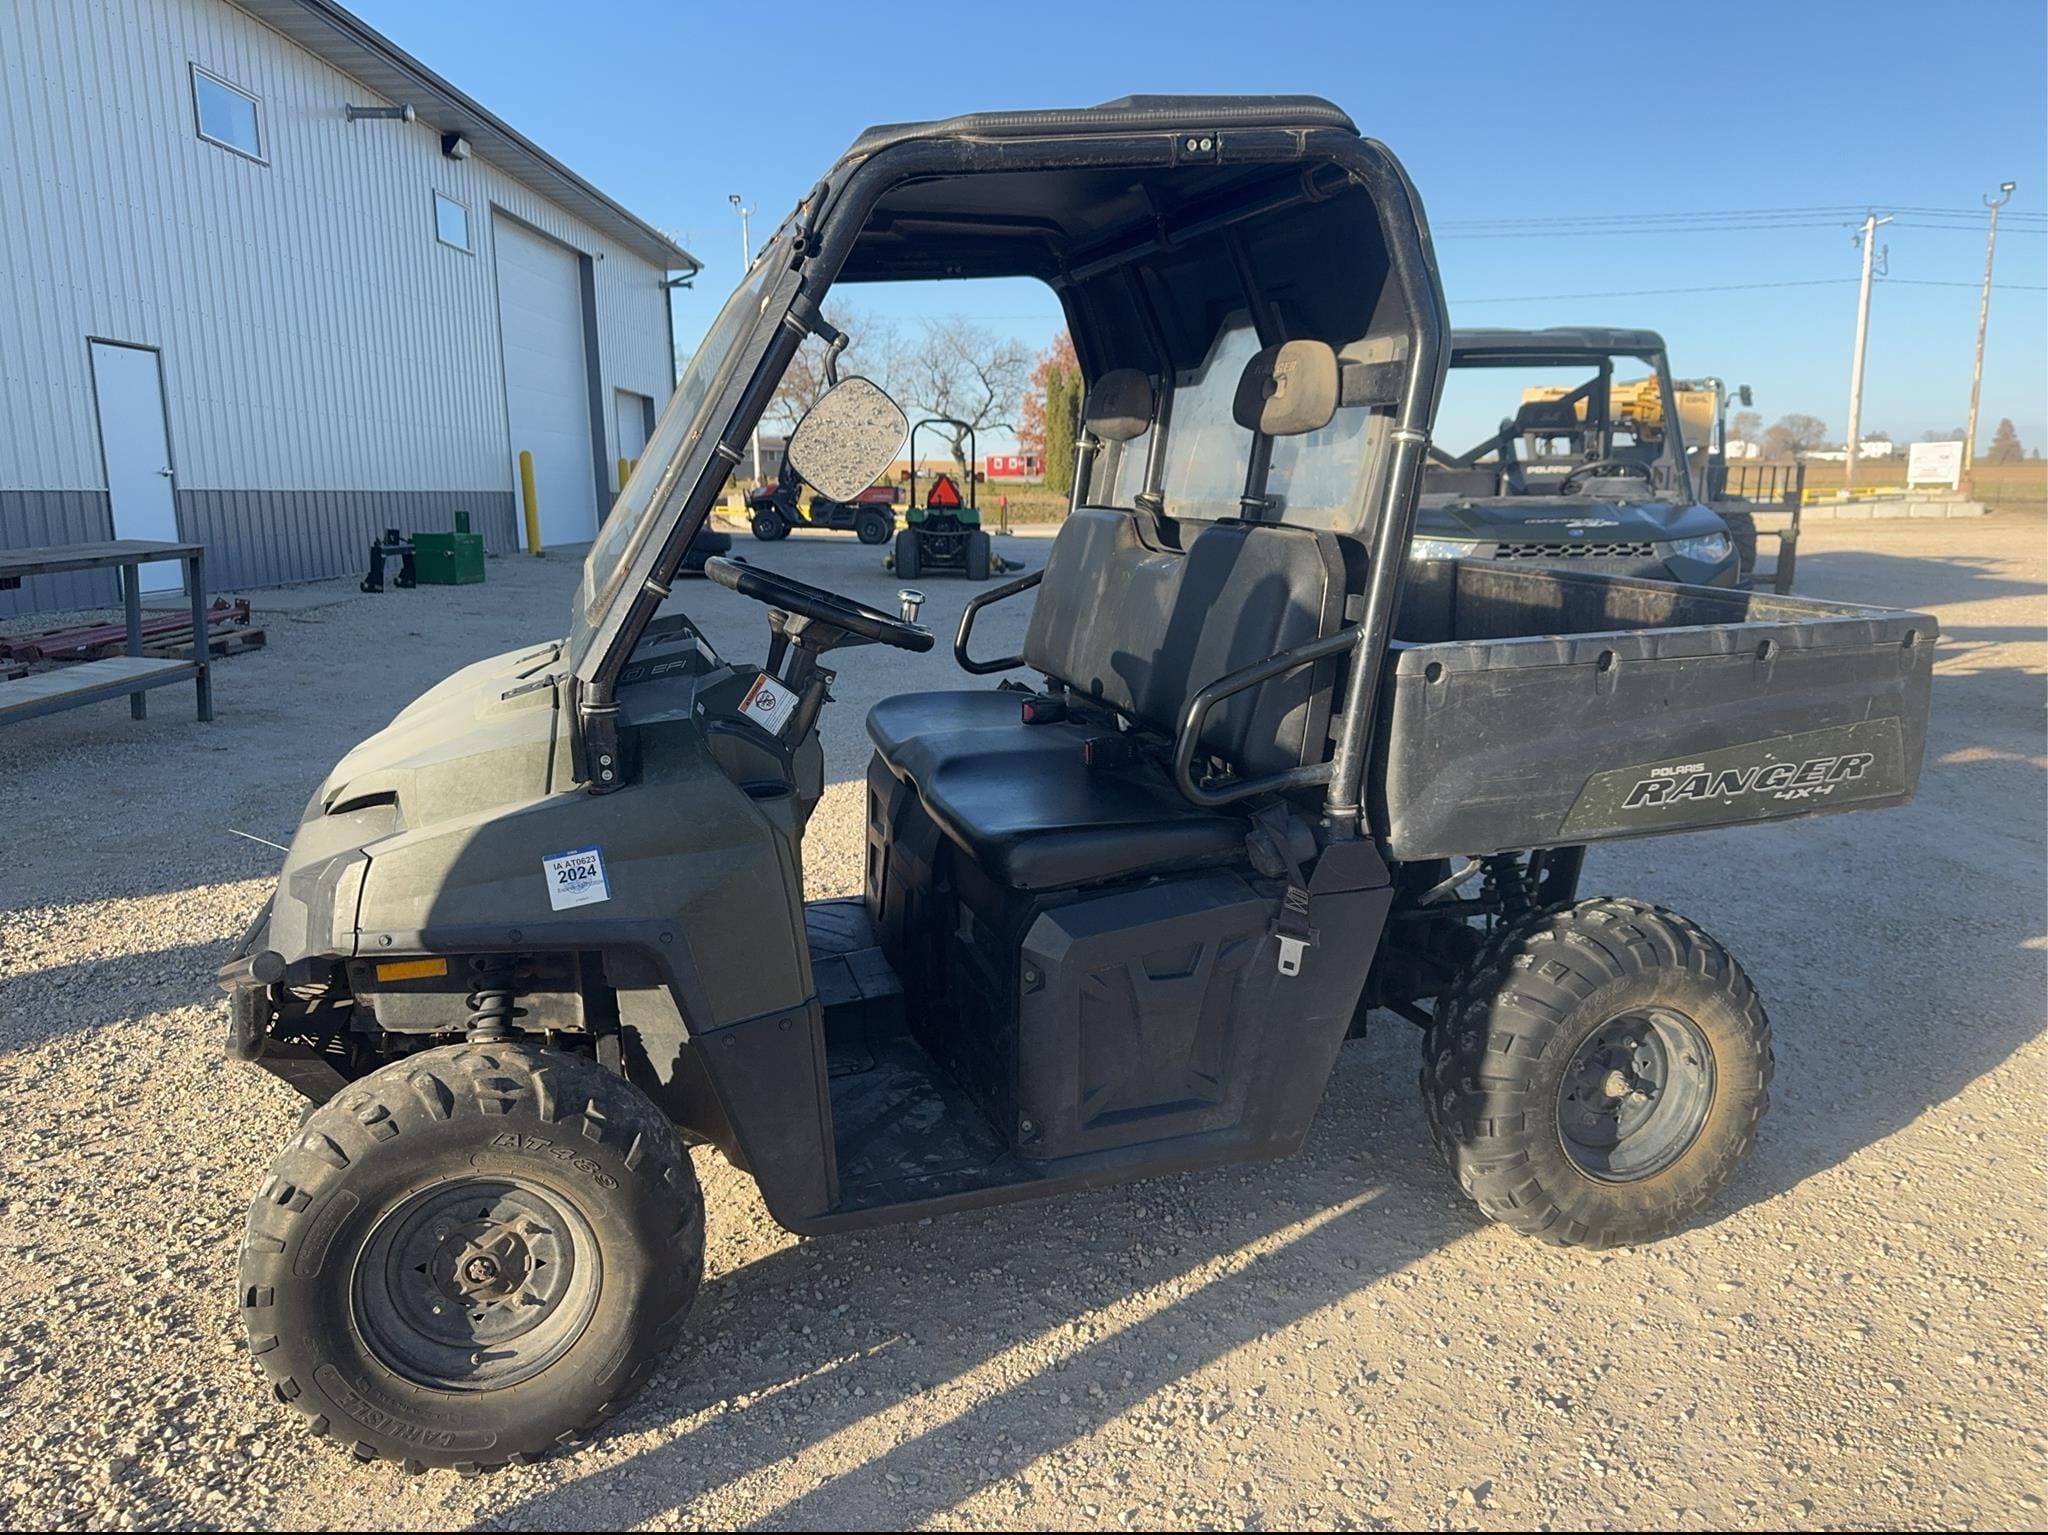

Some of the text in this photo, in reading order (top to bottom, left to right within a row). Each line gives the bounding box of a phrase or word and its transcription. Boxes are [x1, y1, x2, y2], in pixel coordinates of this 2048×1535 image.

[1526, 465, 1573, 475] POLARIS
[650, 660, 687, 675] EFI
[1650, 763, 1705, 778] POLARIS
[1621, 753, 1875, 809] RANGER
[553, 855, 596, 871] IA AT0623
[557, 863, 597, 884] 2024
[336, 1391, 457, 1447] CARLISLE
